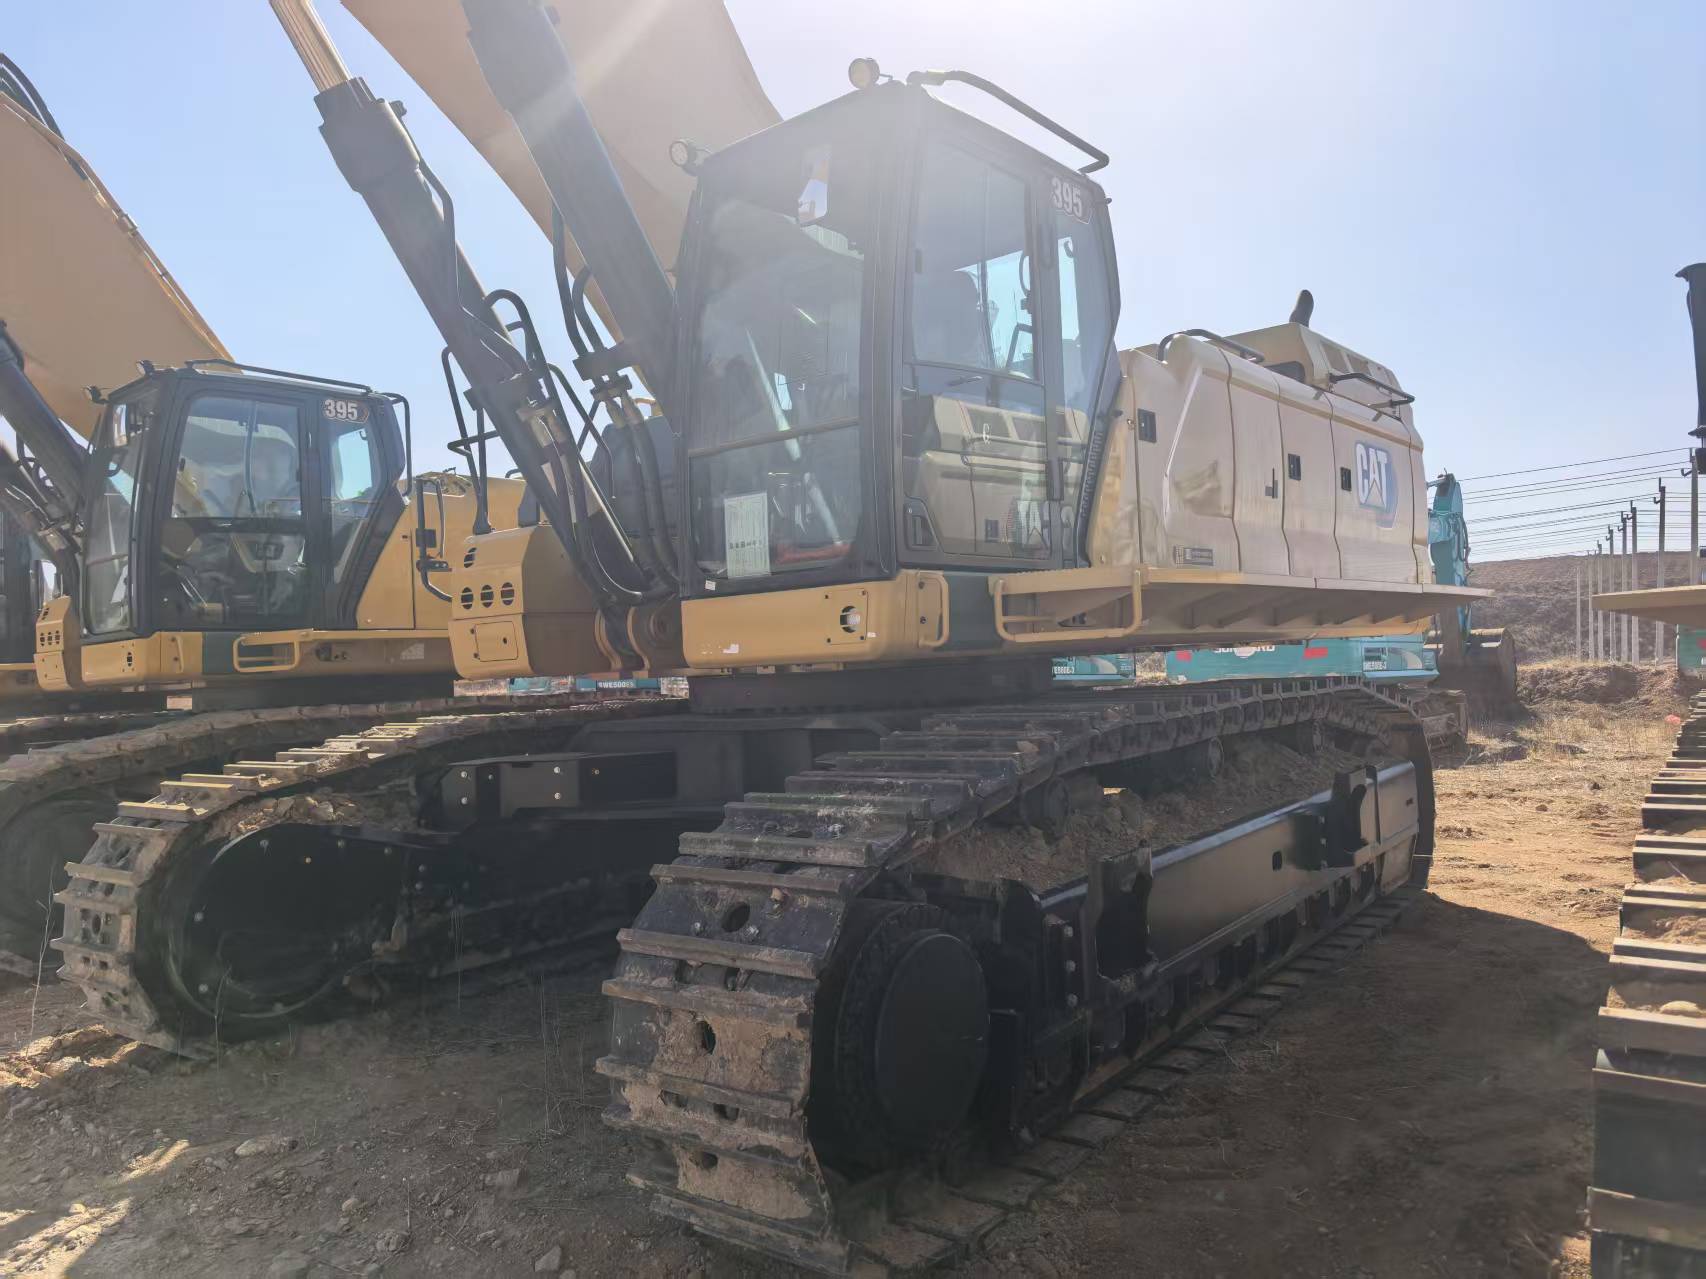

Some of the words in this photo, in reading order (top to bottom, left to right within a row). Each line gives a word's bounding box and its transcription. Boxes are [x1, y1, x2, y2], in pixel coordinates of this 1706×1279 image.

[1051, 177, 1083, 218] 395
[324, 399, 358, 421] 395
[1356, 442, 1388, 510] CAT
